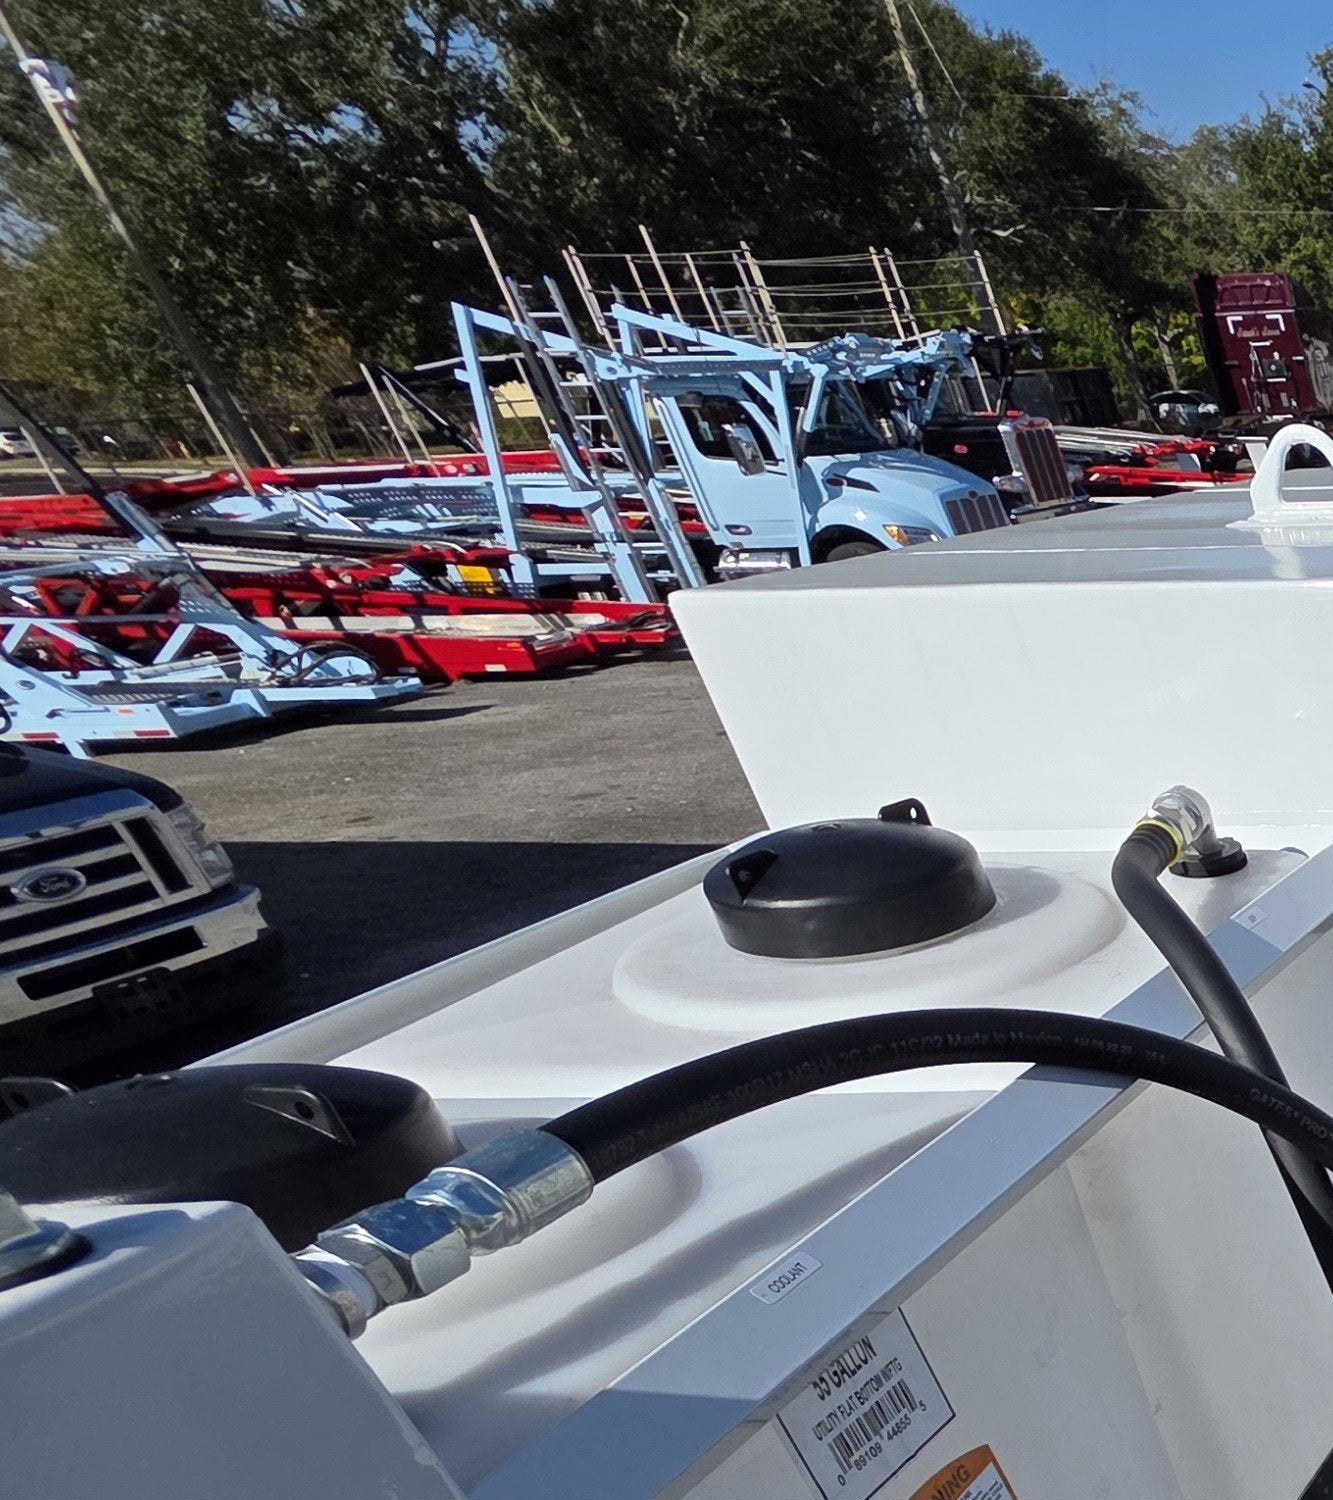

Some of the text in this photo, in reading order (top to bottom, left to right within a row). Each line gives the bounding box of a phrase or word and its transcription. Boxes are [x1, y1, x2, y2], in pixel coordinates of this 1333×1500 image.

[768, 1262, 808, 1293] COOLANT
[812, 1409, 841, 1441] UTILITY
[837, 1394, 858, 1420] FLAT
[854, 1372, 885, 1406] BOTTOM
[837, 1474, 846, 1486] 0
[853, 1442, 883, 1471] 89109
[919, 1400, 927, 1412] 5
